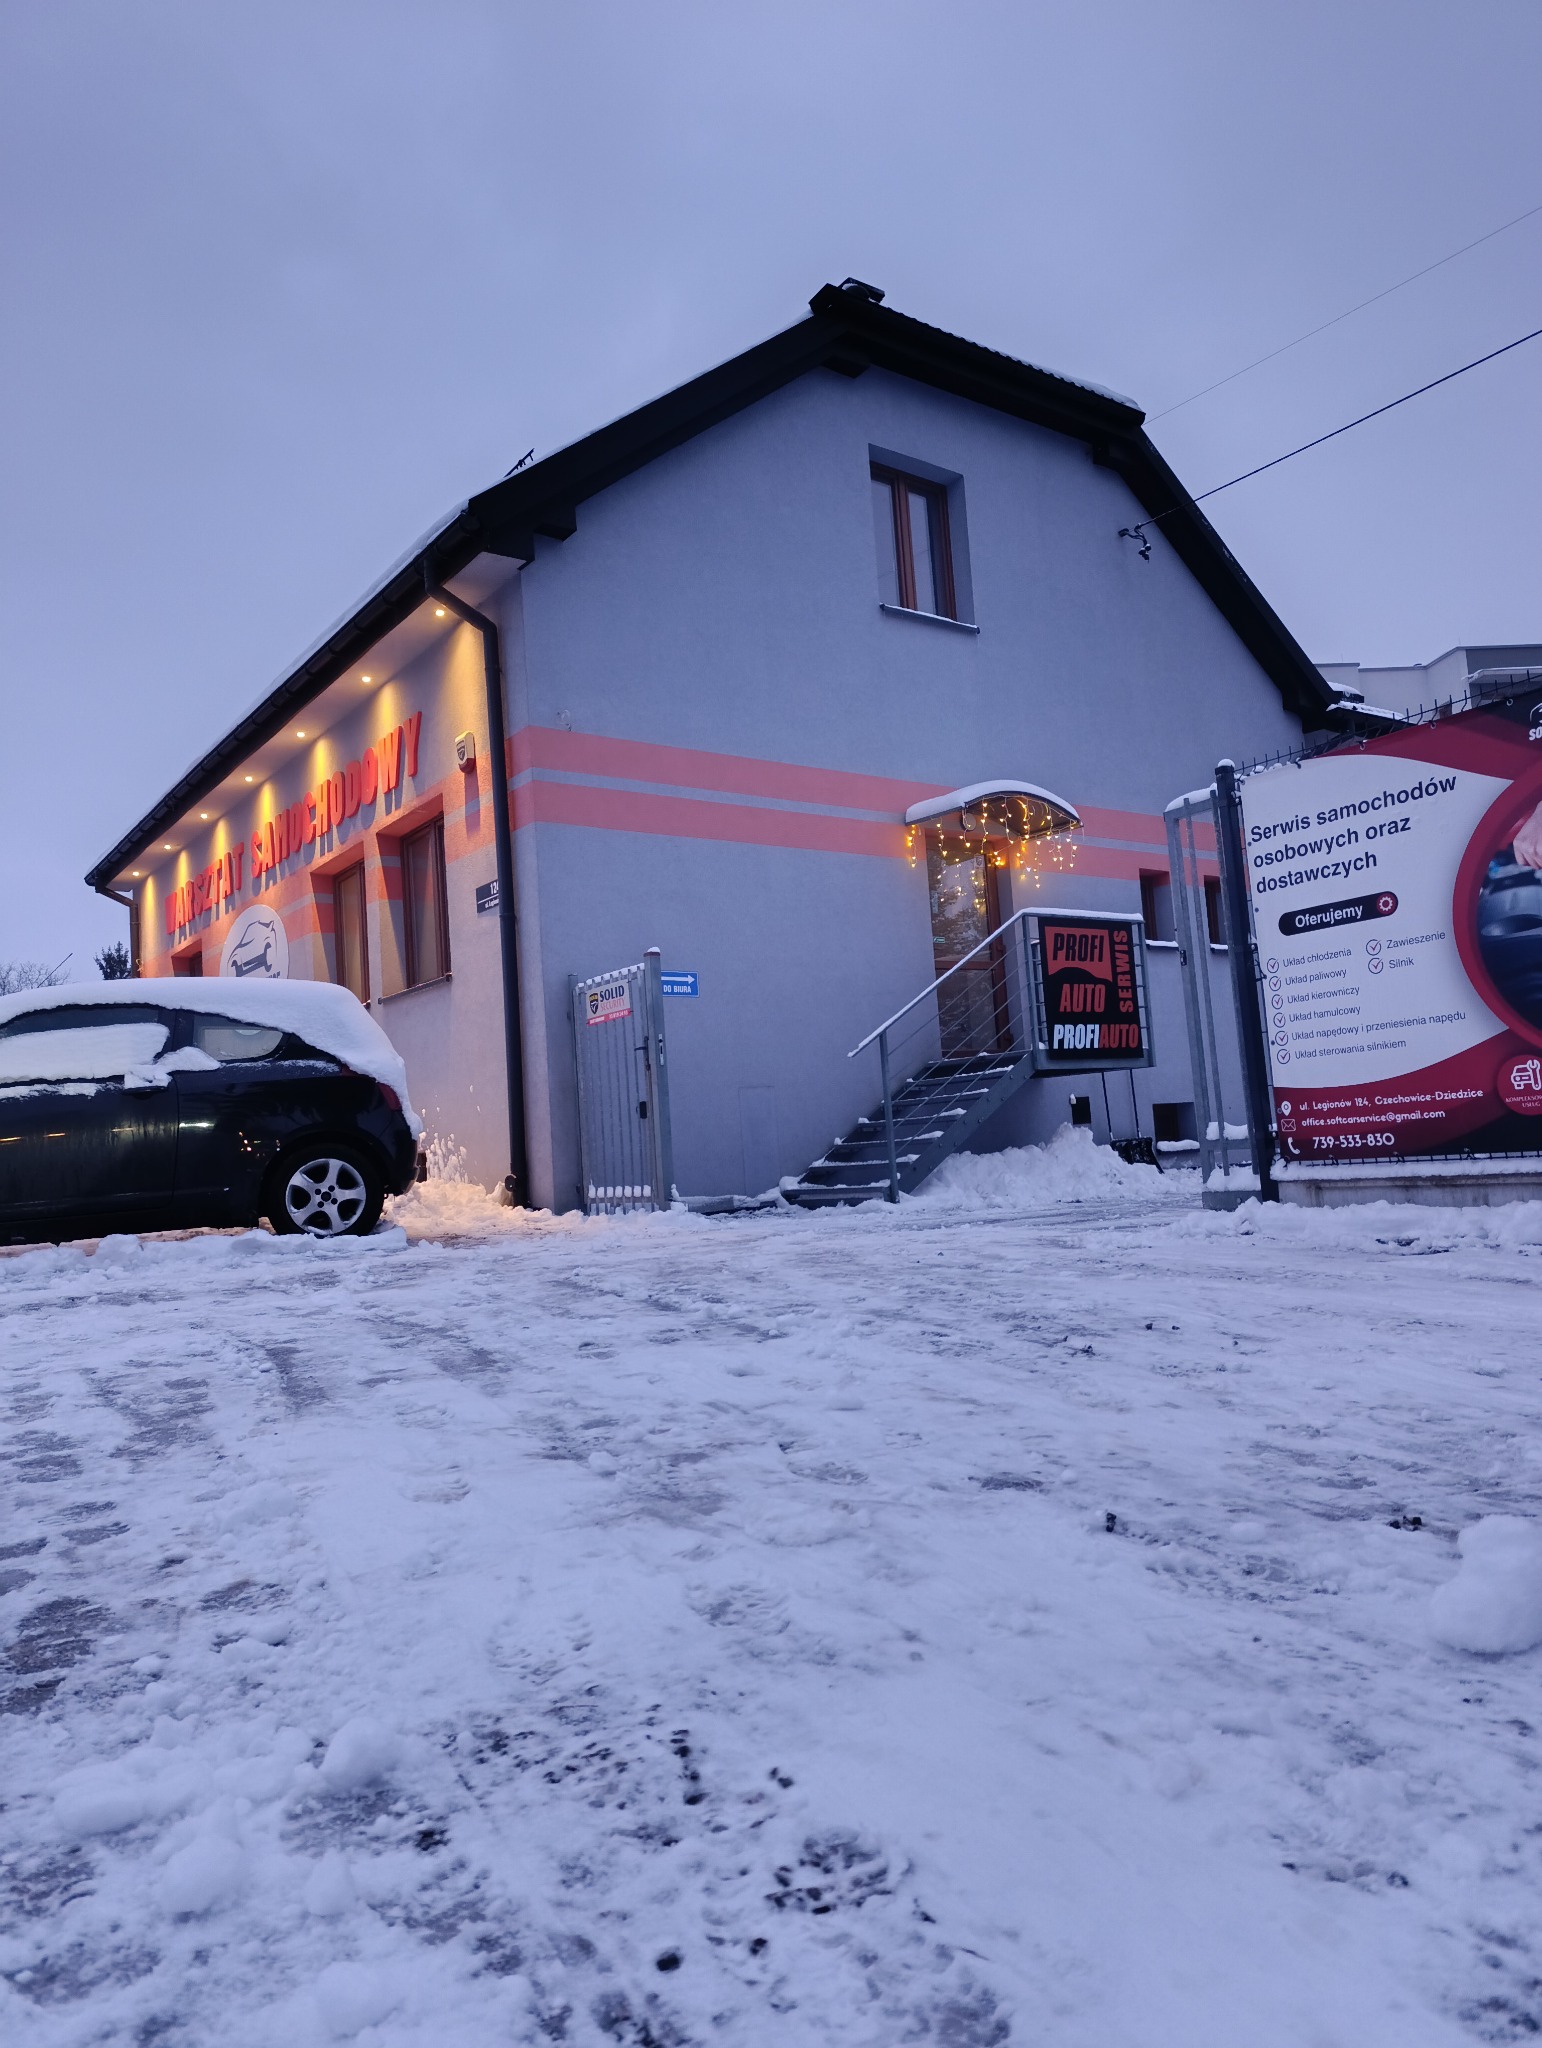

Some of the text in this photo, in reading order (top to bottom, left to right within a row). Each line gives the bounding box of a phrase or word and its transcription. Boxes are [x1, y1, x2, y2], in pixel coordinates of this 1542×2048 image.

[251, 711, 422, 878] SAMOCHODOWY
[1251, 776, 1457, 843] Serwis samochodów
[1253, 817, 1411, 867] osobowych oraz
[1256, 851, 1377, 893] dostawczych
[1295, 904, 1363, 928] Oferujemy
[1053, 933, 1104, 962] PROFI
[1387, 931, 1446, 949] Zawieszenie
[1114, 930, 1134, 1013] SERWIS
[1283, 956, 1305, 968] Układ
[1389, 957, 1415, 969] Silnik
[1285, 969, 1347, 986] Układ paliwowy
[600, 985, 625, 1002] SOLID
[663, 985, 692, 993] DO BIURA
[1059, 984, 1106, 1012] AUTO
[1287, 986, 1360, 1004] Układ kierowniczy
[1289, 1006, 1361, 1022] Układ hamulcowy
[1292, 1030, 1315, 1041] Układ
[1316, 1025, 1359, 1038] napędowy
[1366, 1016, 1427, 1033] przeniesienia
[1429, 1011, 1466, 1024] napędu
[1295, 1039, 1407, 1060] Układ sterowania silnikiem
[1299, 1089, 1484, 1112] ul. Legionów 124, Czechowice-Dziedzice
[1301, 1110, 1446, 1127] office.softcarservice@gmail.com
[1312, 1132, 1395, 1149] 739-533-830
